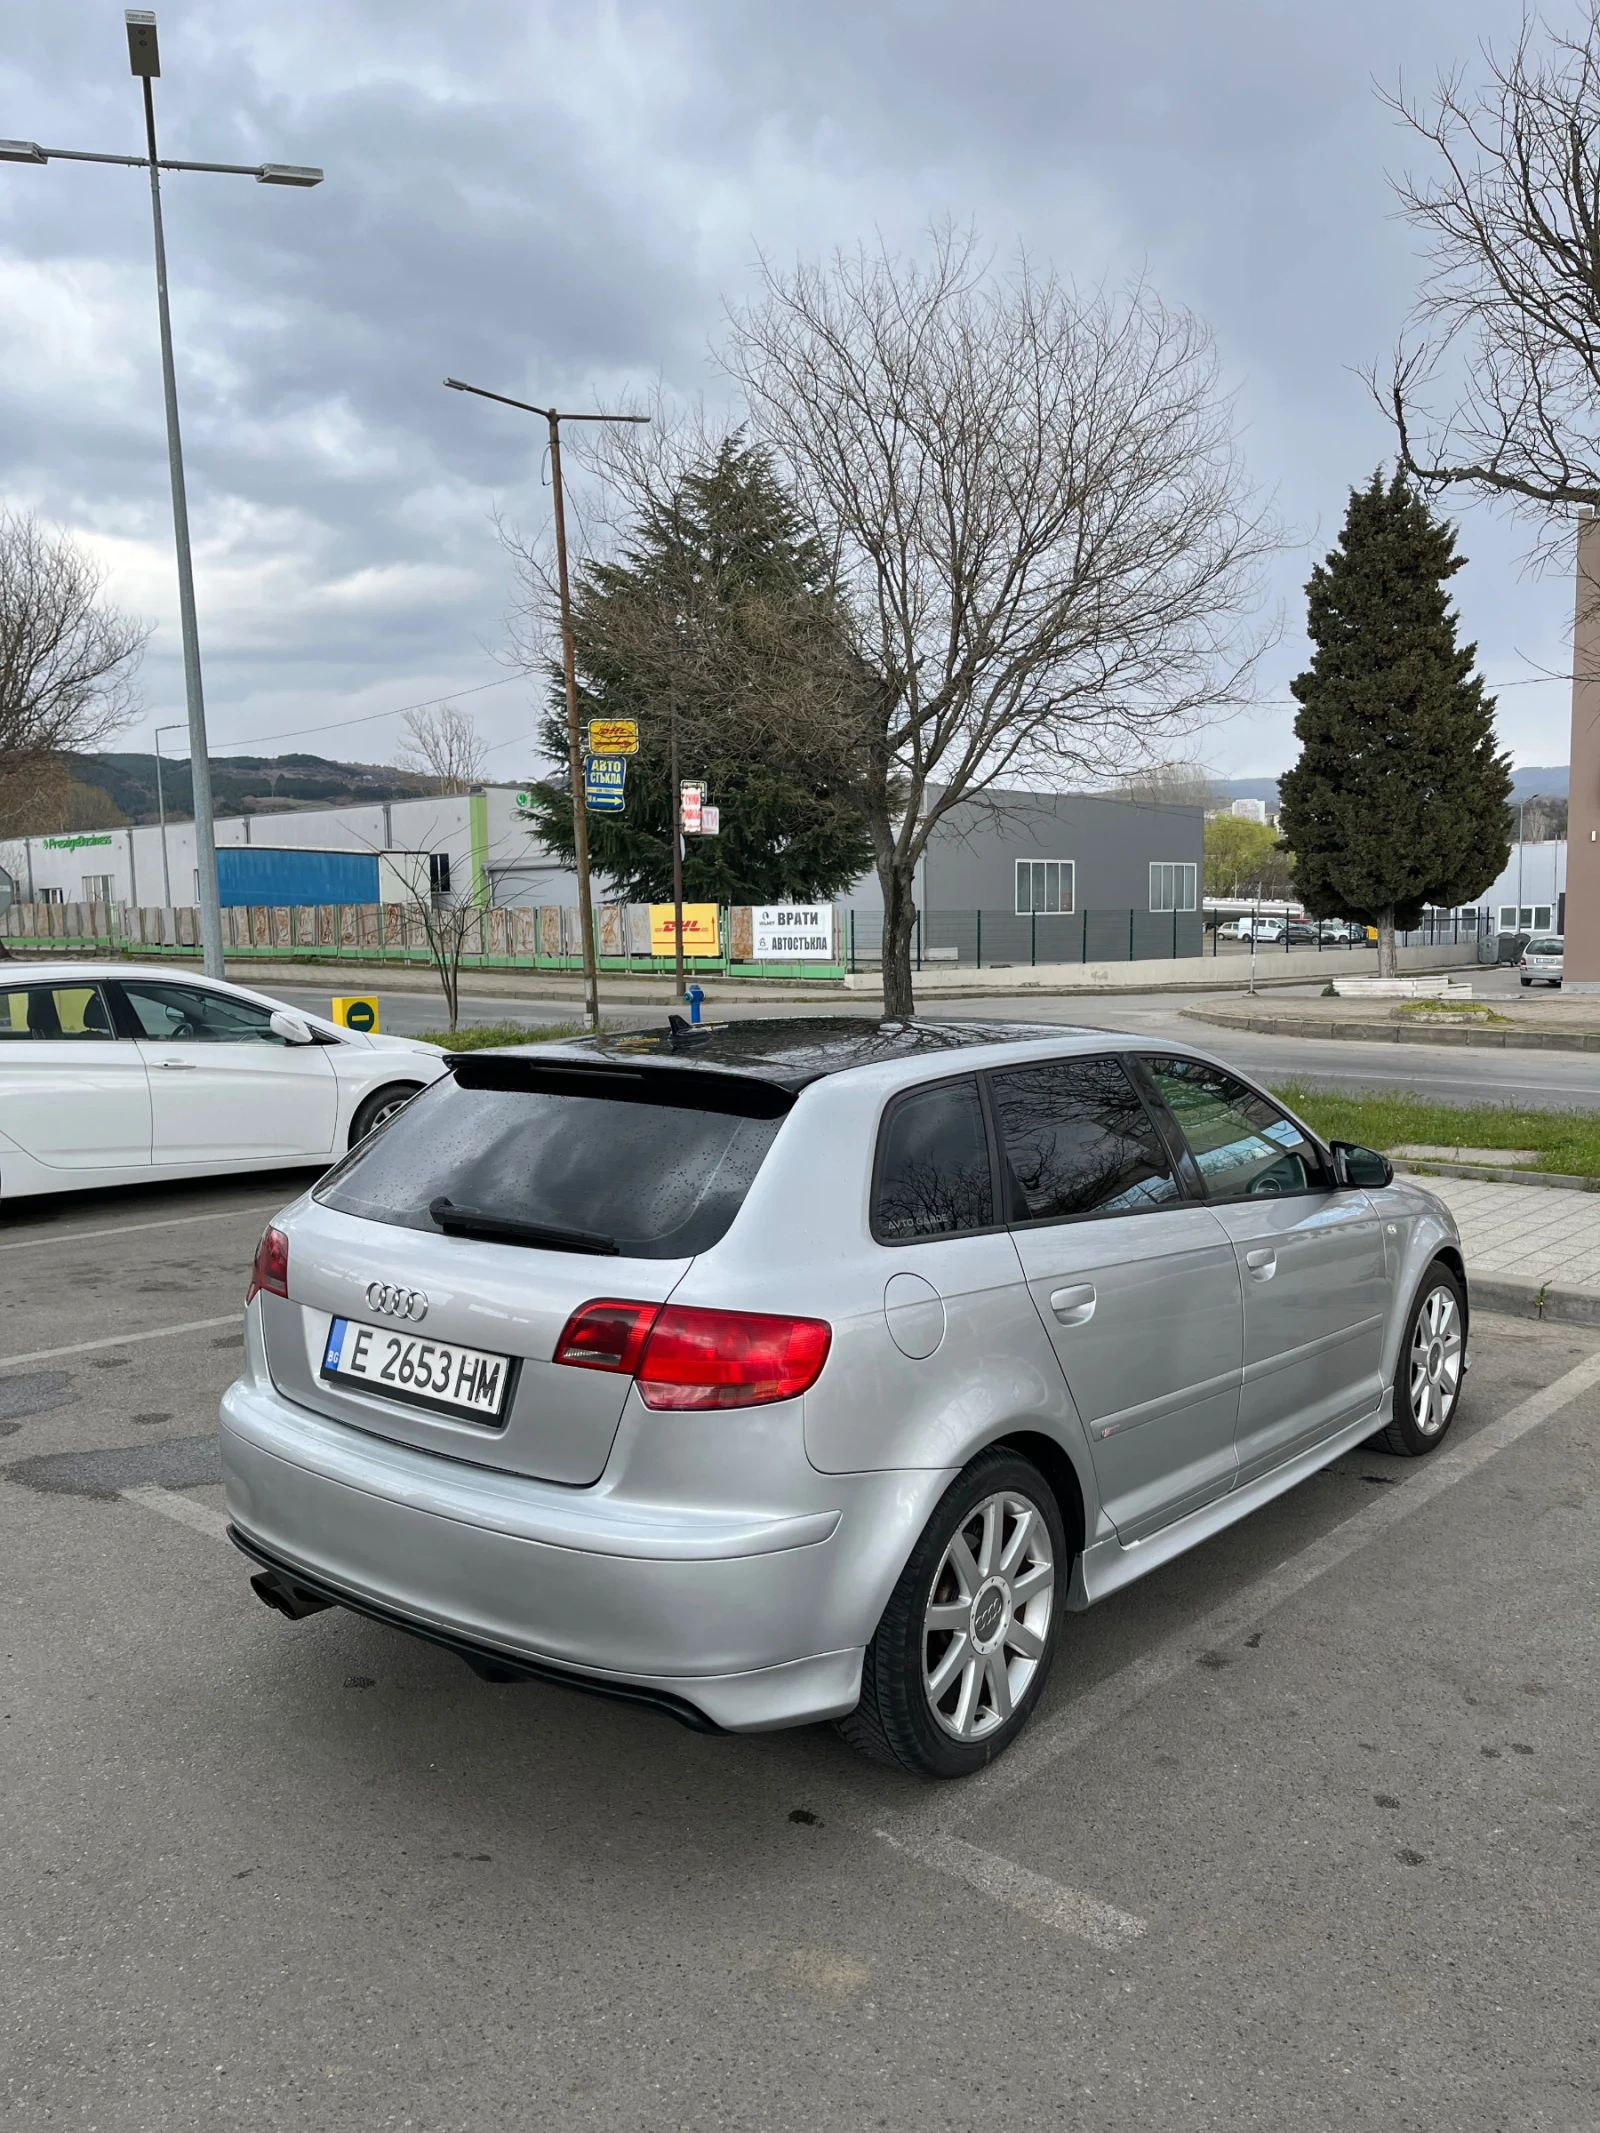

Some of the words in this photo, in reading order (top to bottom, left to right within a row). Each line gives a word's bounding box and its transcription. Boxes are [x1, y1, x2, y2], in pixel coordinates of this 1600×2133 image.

[591, 760, 621, 773] АВТО
[590, 772, 621, 785] СТЪКЛА
[777, 912, 818, 926] ВРАТИ
[663, 920, 701, 932] DHL
[771, 937, 828, 951] АВТОСТЪКЛА
[916, 1213, 948, 1225] GARDE
[327, 1350, 340, 1364] BG
[350, 1329, 373, 1373] E
[380, 1337, 453, 1394] 2653
[453, 1354, 501, 1407] HM
